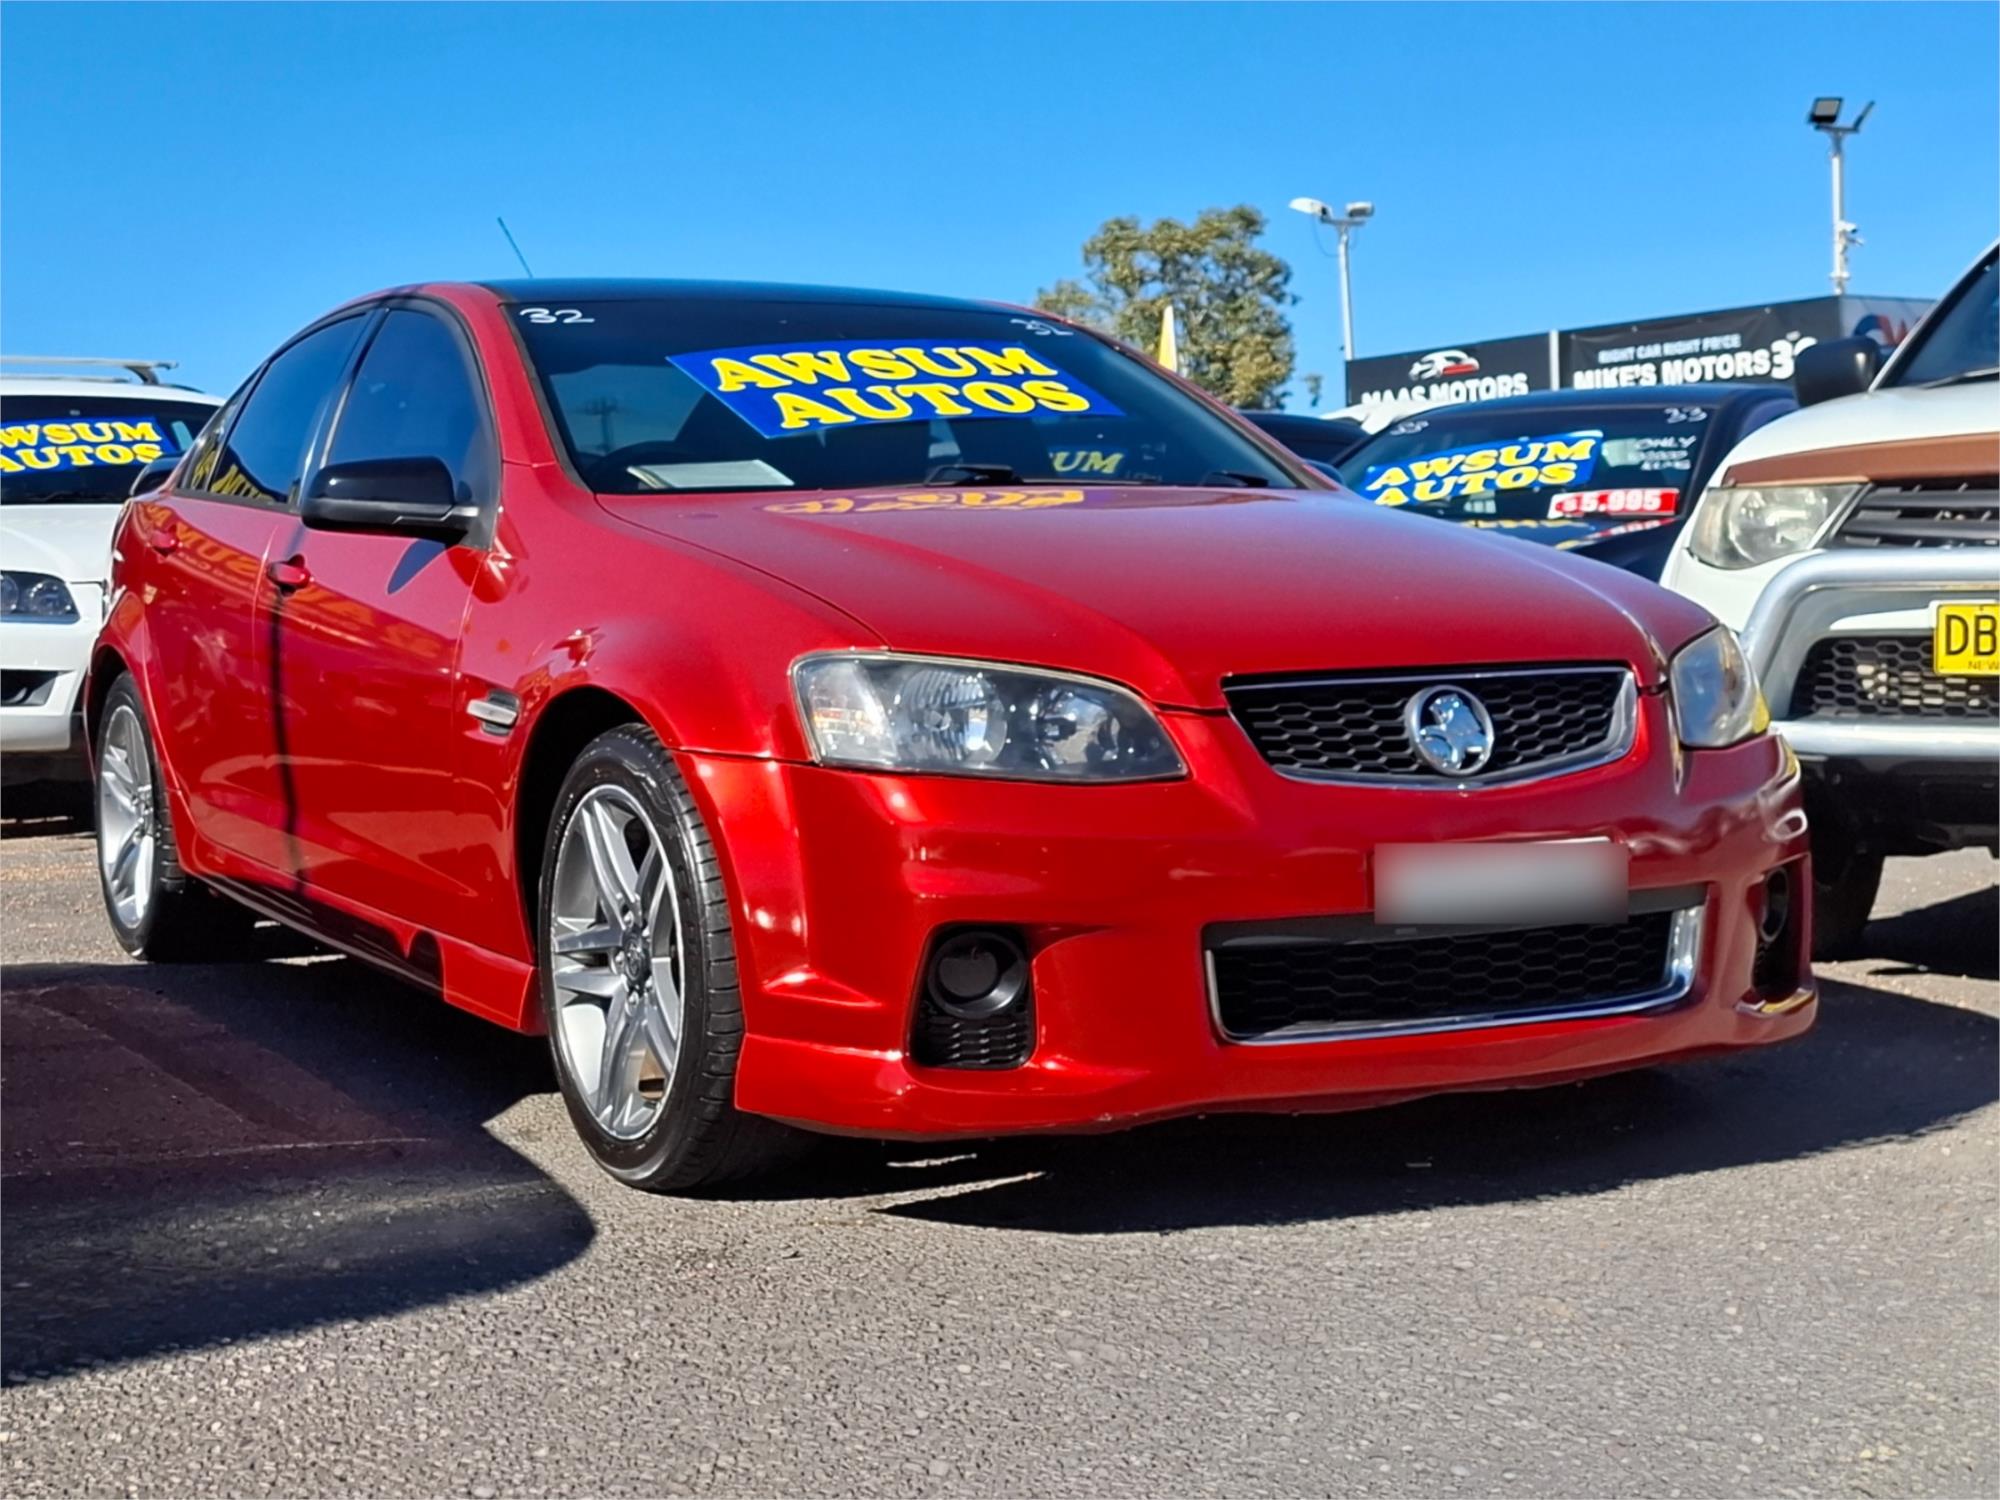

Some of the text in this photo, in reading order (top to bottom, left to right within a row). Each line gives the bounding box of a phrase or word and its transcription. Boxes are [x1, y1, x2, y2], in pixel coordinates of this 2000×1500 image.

[520, 308, 595, 323] 32
[711, 345, 1059, 392] AWSUM
[1429, 372, 1529, 402] MOTORS
[1573, 363, 1656, 390] MIKE'S
[1661, 349, 1771, 386] MOTORS
[772, 380, 1090, 429] AUTOS
[0, 422, 162, 449] WSUM
[1366, 439, 1596, 491] AWSUM
[1375, 463, 1578, 506] AUTOS
